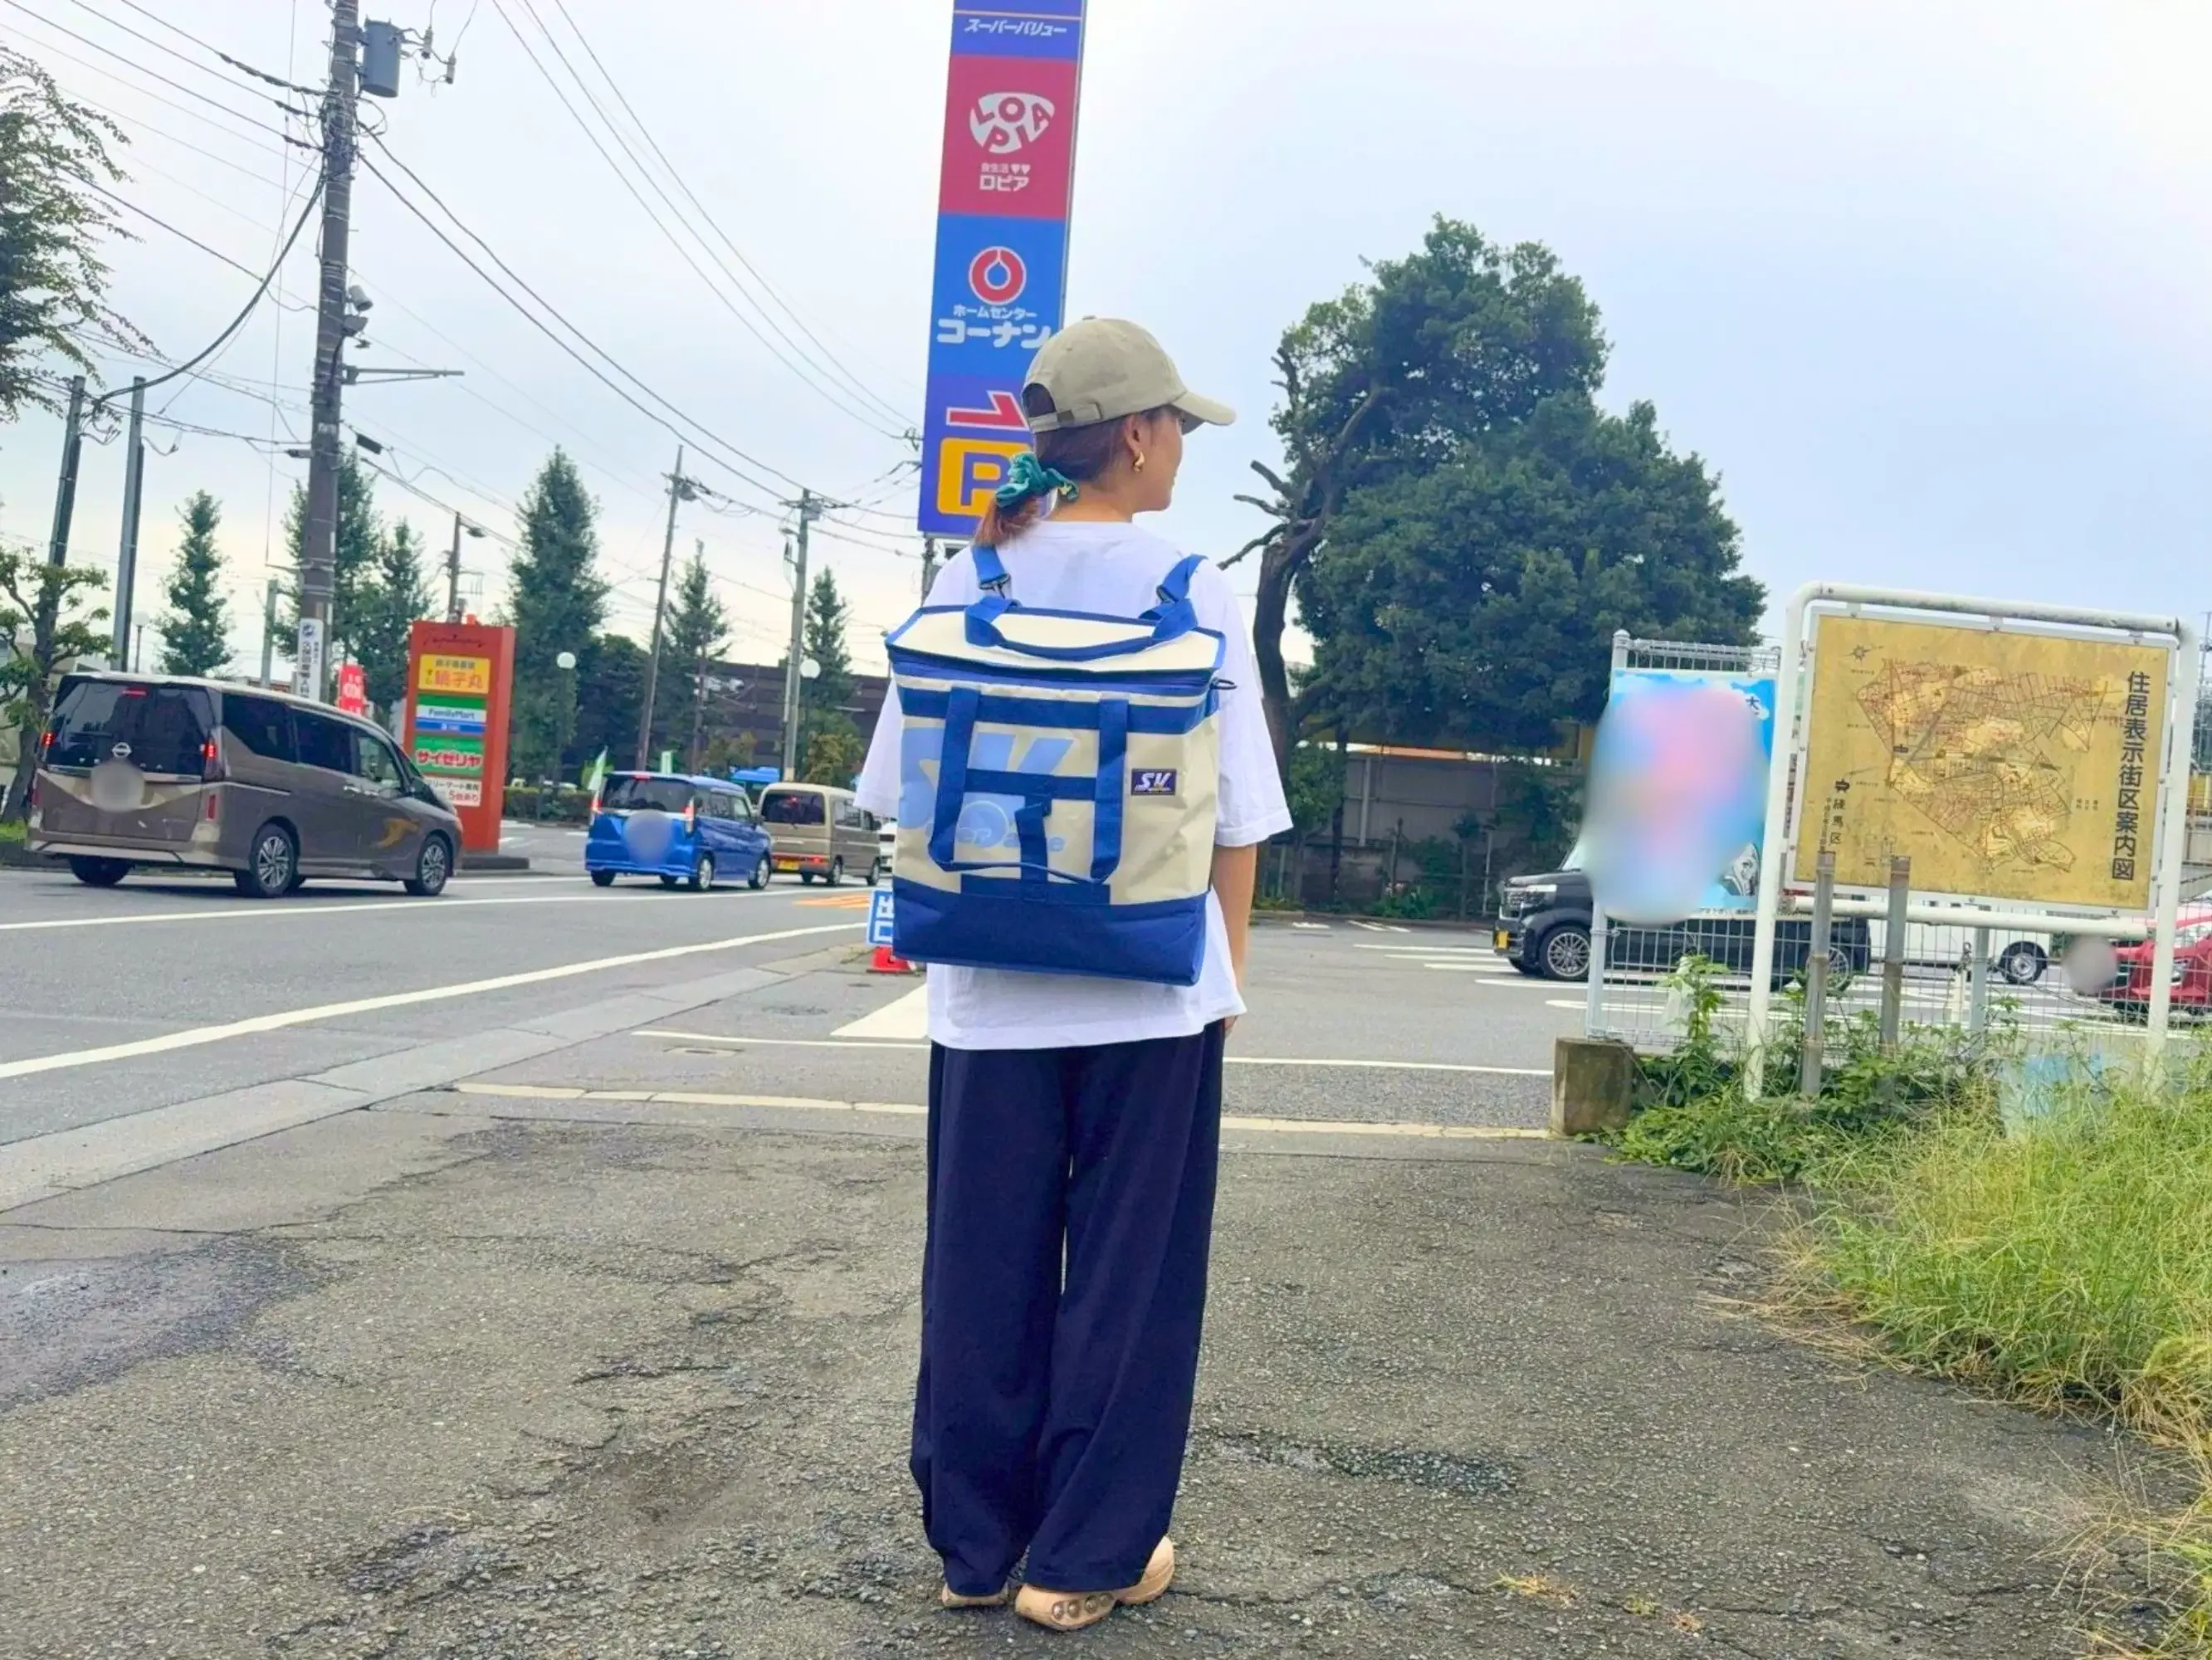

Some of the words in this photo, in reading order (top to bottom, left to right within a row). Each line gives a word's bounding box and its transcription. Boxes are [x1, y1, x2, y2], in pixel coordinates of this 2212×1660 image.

[964, 18, 1067, 37] スーパーバリュー
[969, 92, 1055, 154] LOPIA
[979, 174, 1030, 192] ロピア
[953, 304, 1038, 321] ホームセンター
[936, 318, 1052, 349] コーナン
[960, 452, 1009, 506] P
[417, 749, 482, 769] サイゼリヤ
[2112, 670, 2151, 881] 住居表示街区案内図
